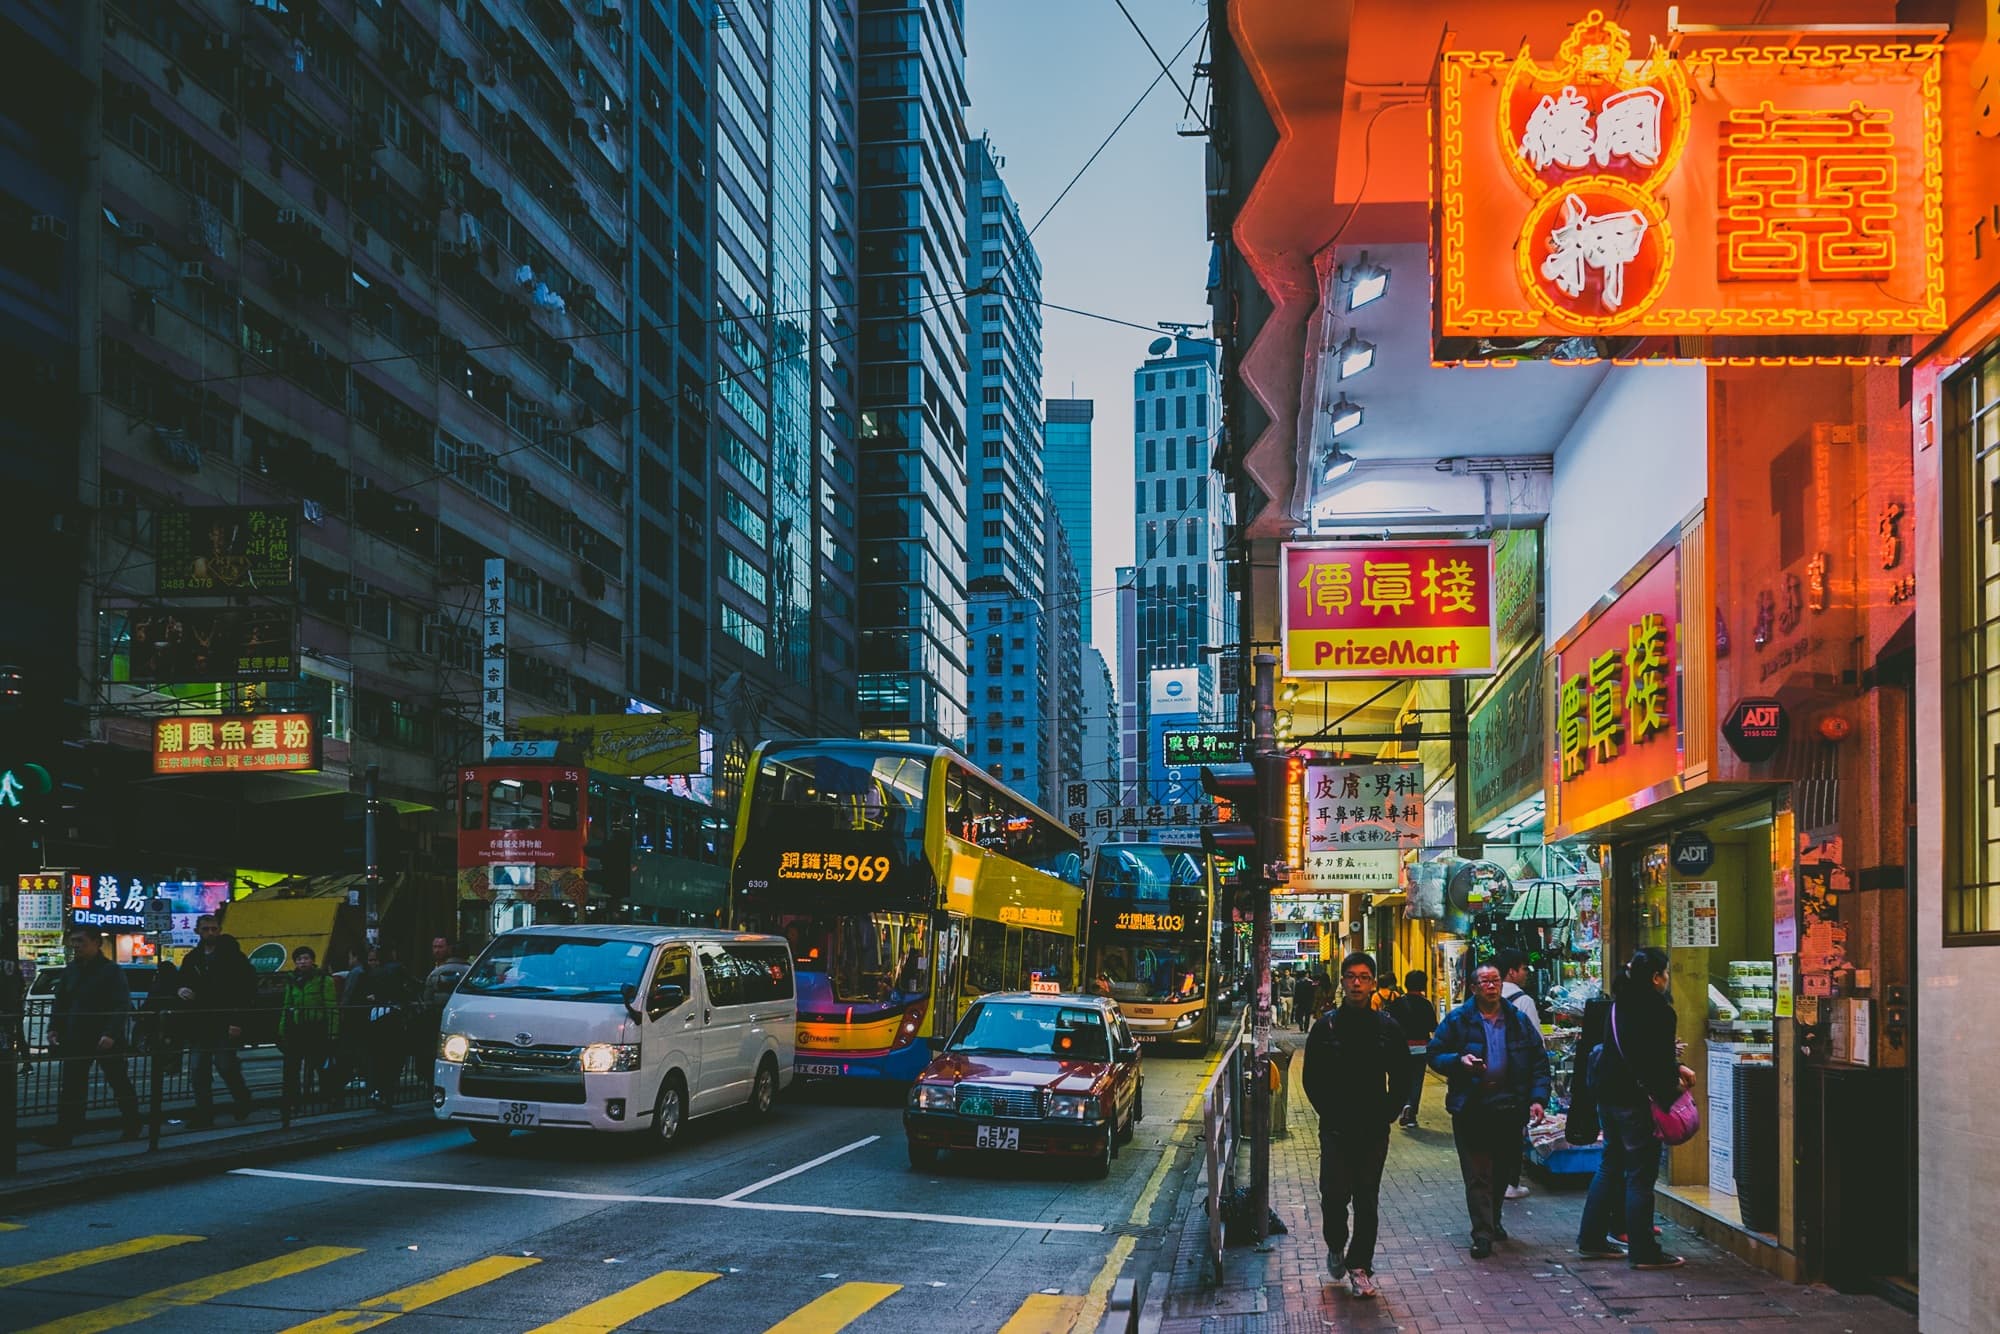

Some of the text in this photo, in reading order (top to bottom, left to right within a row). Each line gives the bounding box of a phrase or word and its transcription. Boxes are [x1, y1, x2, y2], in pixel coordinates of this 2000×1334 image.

[1315, 639, 1460, 665] PrizeMart
[1742, 707, 1779, 727] ADT
[158, 718, 311, 753] 潮興魚蛋粉
[511, 742, 538, 756] 55
[465, 771, 474, 781] 55
[565, 771, 578, 781] 55
[1678, 846, 1708, 861] ADT
[781, 852, 842, 870] 銅鑼灣
[778, 867, 844, 882] Causeway Bay
[843, 855, 890, 882] 969
[748, 880, 769, 888] 6309
[1157, 915, 1182, 931] 103
[1034, 984, 1058, 993] TAXI
[511, 1102, 529, 1113] SP
[503, 1112, 536, 1125] 9017
[978, 1136, 1017, 1149] 8672
